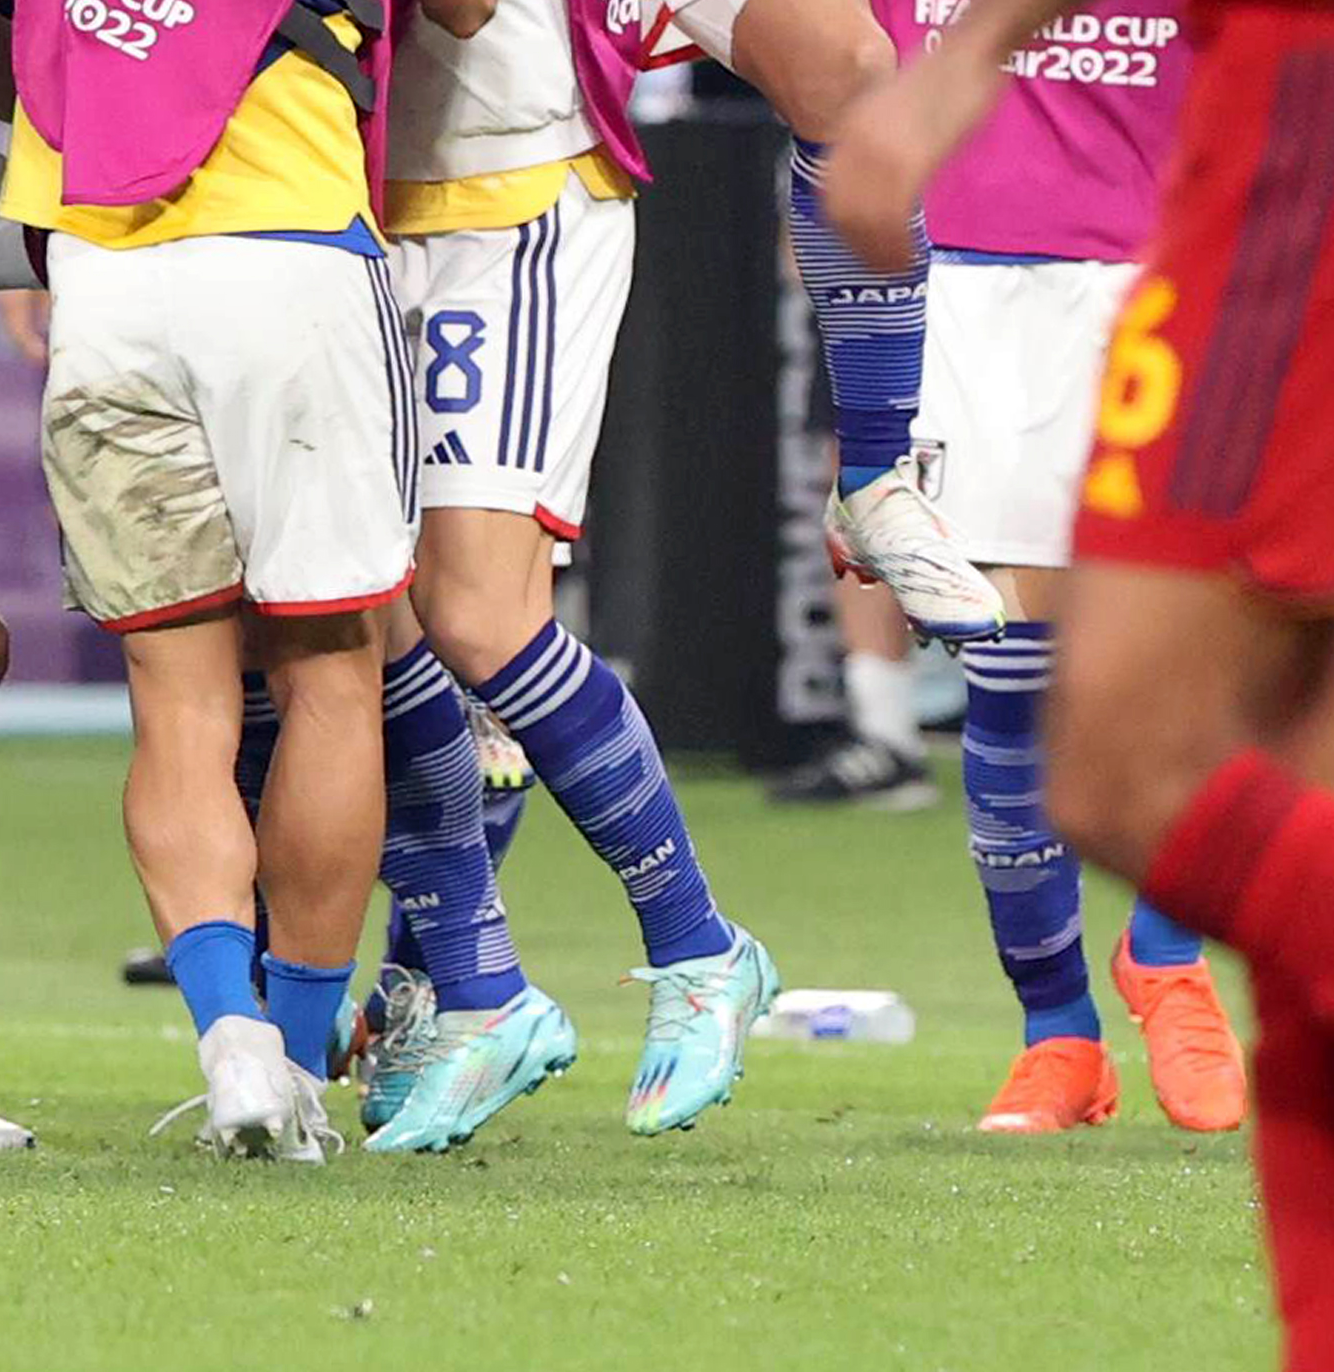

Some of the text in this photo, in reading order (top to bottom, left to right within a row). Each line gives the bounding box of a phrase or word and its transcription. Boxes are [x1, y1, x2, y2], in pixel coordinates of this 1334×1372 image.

[1104, 15, 1179, 48] CUP
[830, 282, 929, 305] JAPA
[425, 309, 487, 414] 8
